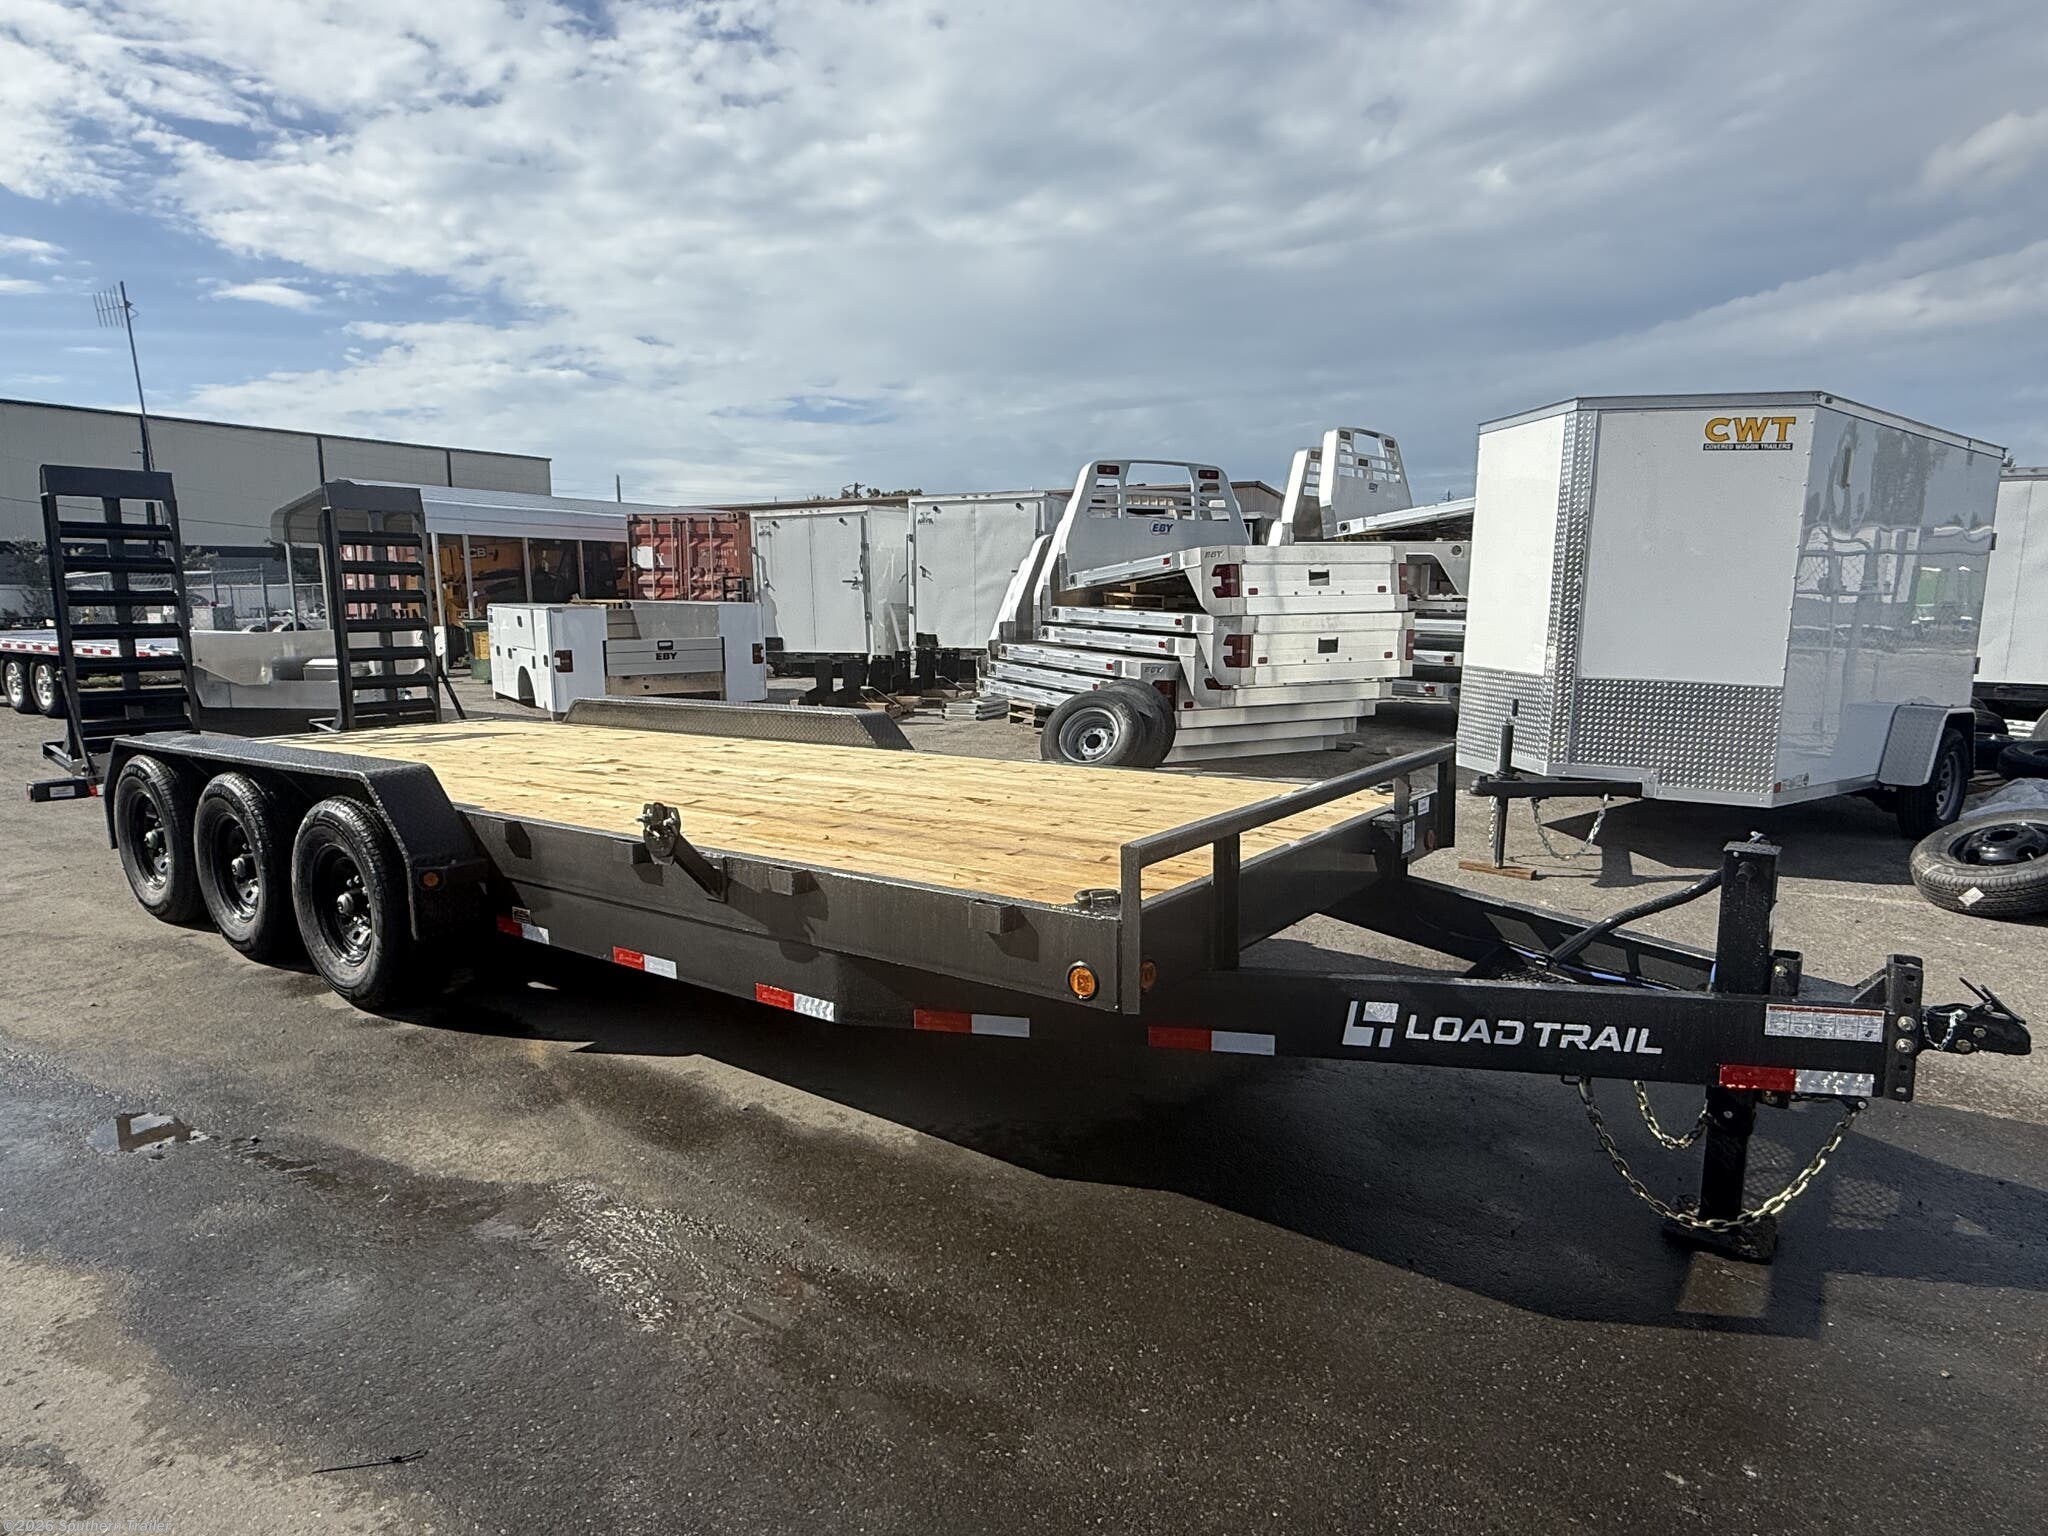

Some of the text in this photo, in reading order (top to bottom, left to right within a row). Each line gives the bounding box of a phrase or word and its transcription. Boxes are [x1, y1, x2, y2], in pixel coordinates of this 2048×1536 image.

[1705, 416, 1796, 442] CWT
[1152, 523, 1173, 533] EBY
[1204, 550, 1225, 559] EBY
[656, 652, 677, 661] EBY
[1405, 1014, 1663, 1055] LOAD TRAIL
